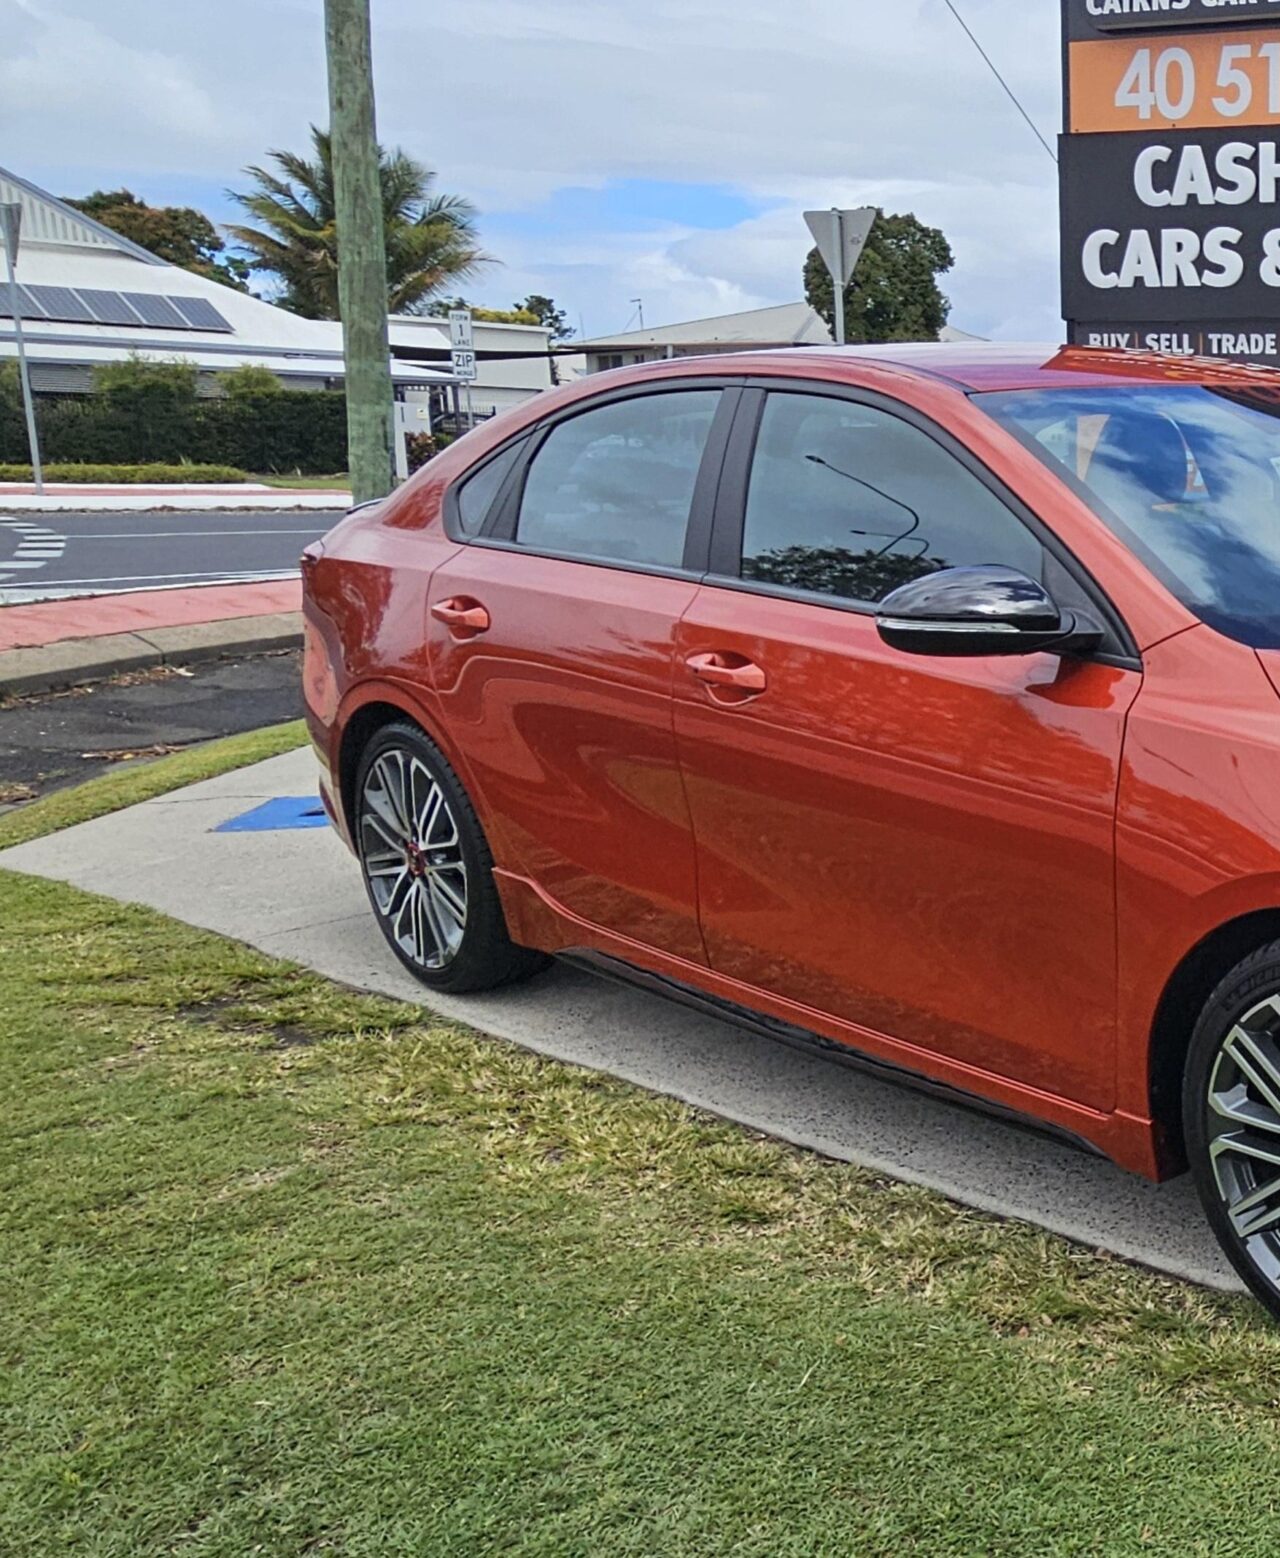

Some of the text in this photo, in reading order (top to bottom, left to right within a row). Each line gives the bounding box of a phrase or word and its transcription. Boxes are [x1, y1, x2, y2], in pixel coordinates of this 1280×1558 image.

[1115, 47, 1195, 120] 40
[1081, 226, 1244, 289] CARS
[455, 354, 473, 368] ZIP
[1145, 333, 1195, 354] SELL
[1208, 333, 1278, 355] TRADE
